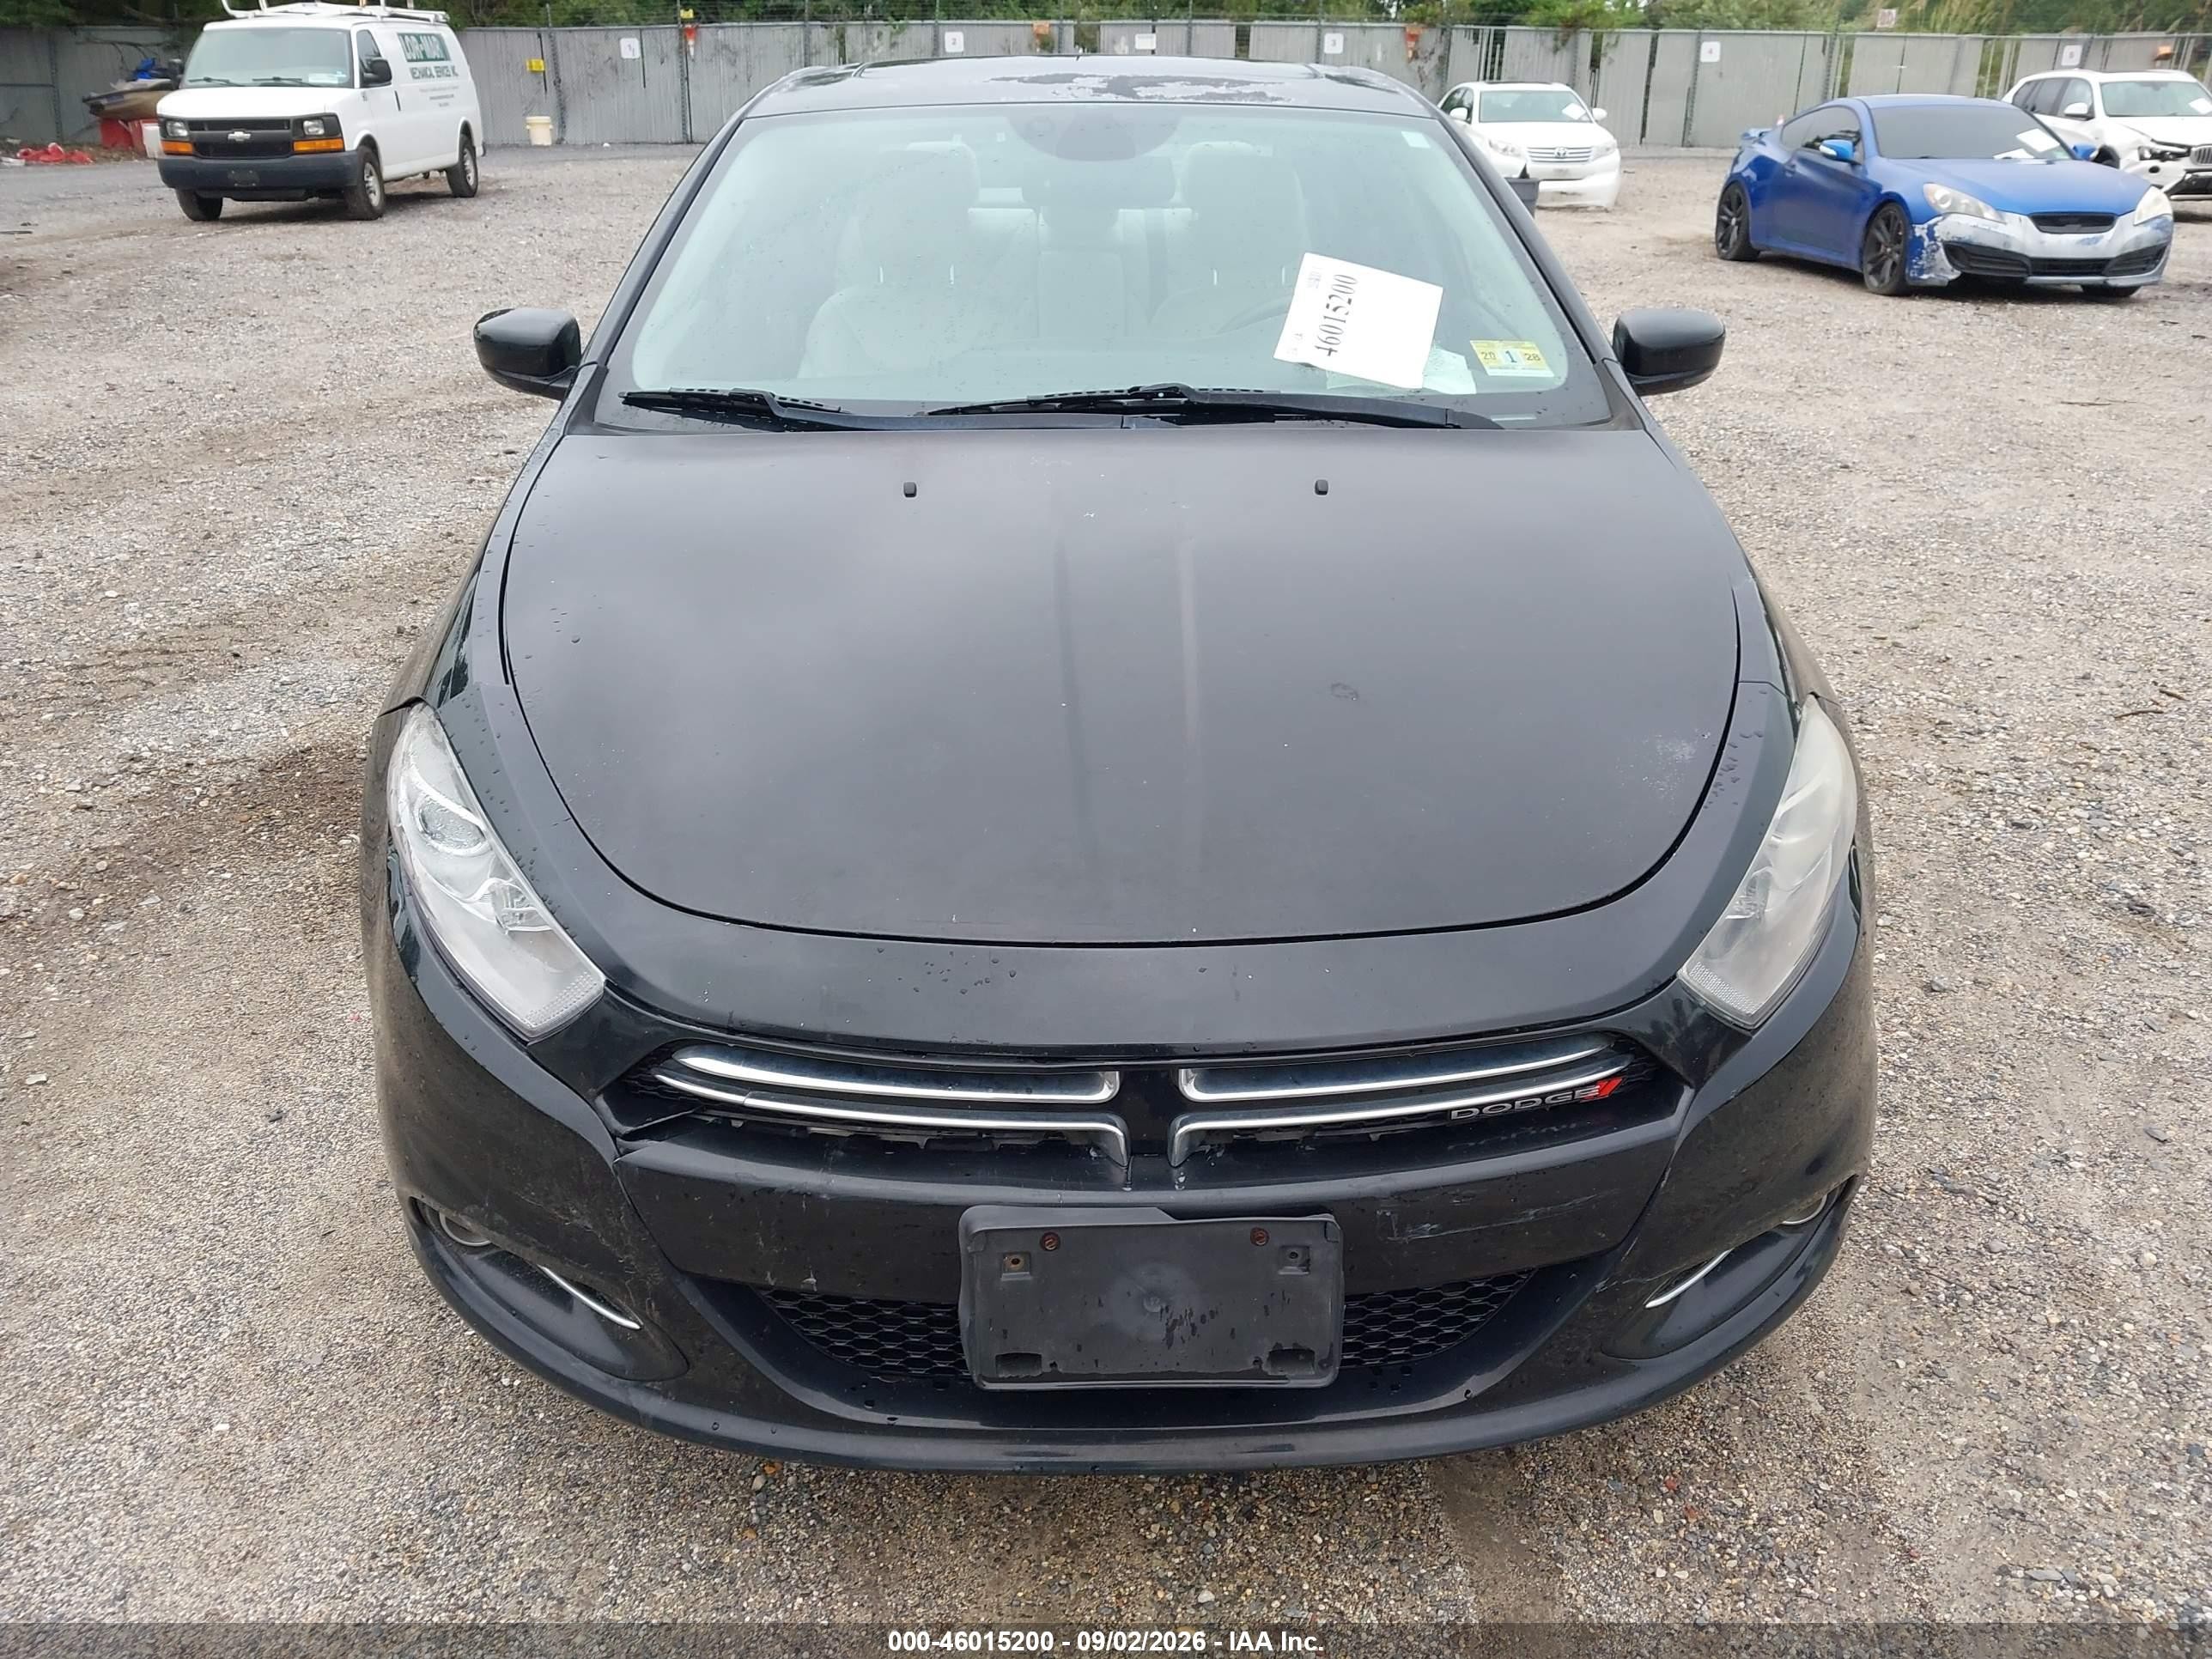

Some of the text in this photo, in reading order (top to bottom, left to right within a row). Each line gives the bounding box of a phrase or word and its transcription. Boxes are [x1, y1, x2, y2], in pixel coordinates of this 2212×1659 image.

[1314, 274, 1358, 357] 46015200
[1480, 350, 1541, 363] 20 1 28
[1450, 1085, 1601, 1121] DODGE
